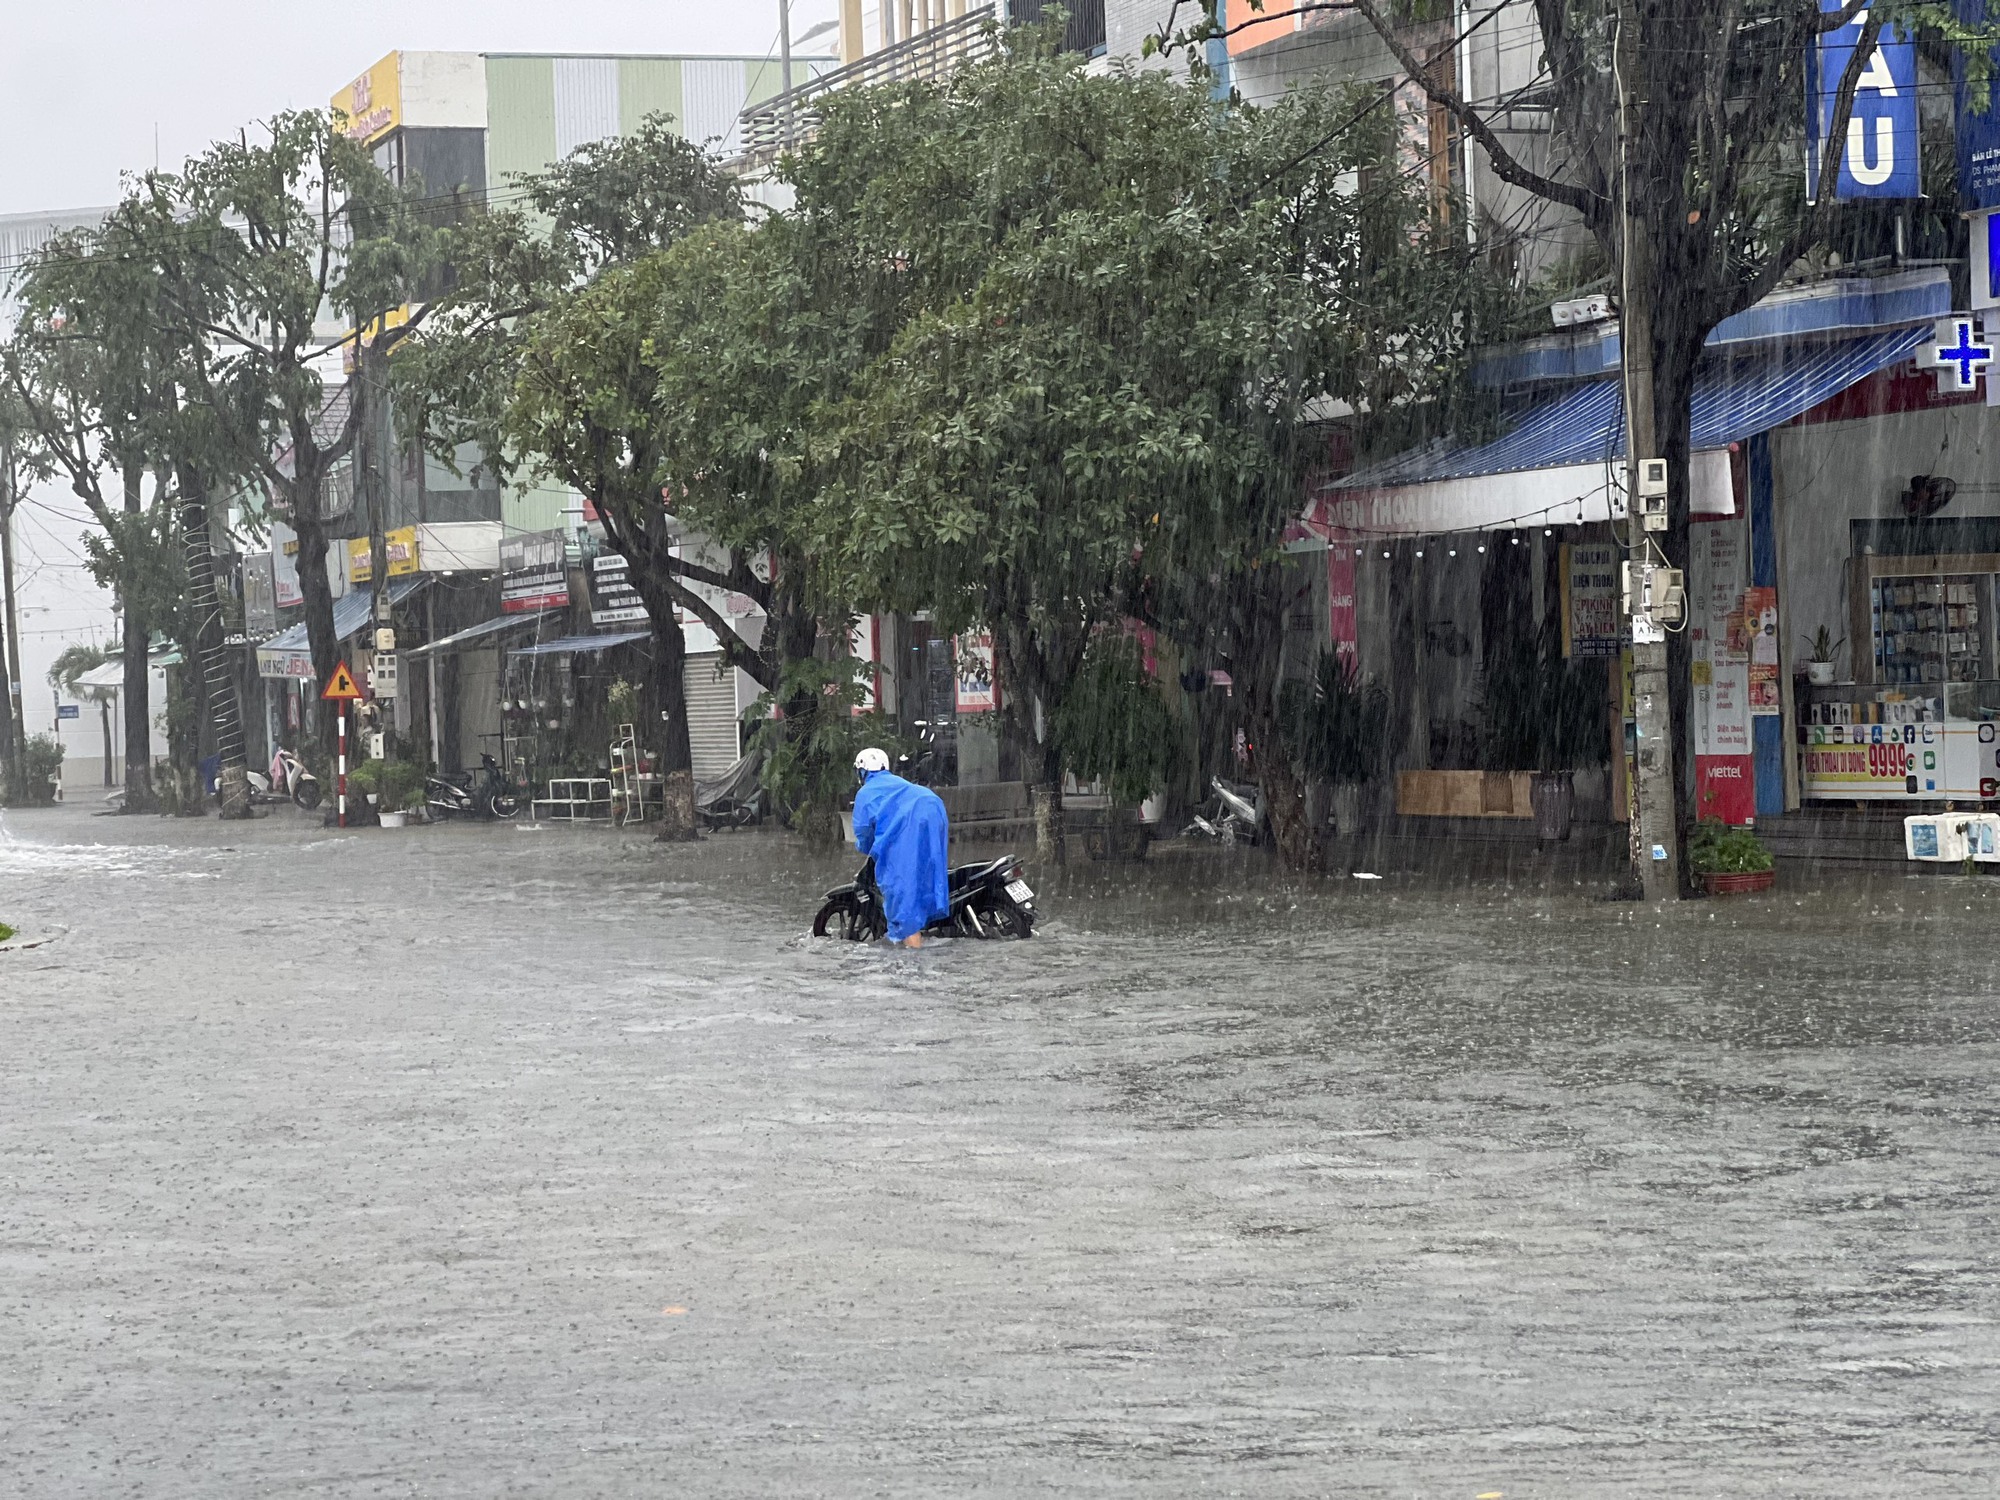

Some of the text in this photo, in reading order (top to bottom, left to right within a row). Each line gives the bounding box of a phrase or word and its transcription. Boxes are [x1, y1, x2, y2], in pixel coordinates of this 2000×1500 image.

[1332, 592, 1353, 607] HÀNG
[1840, 752, 1847, 773] DI
[1868, 742, 1907, 777] 9999
[1707, 765, 1742, 778] viettel
